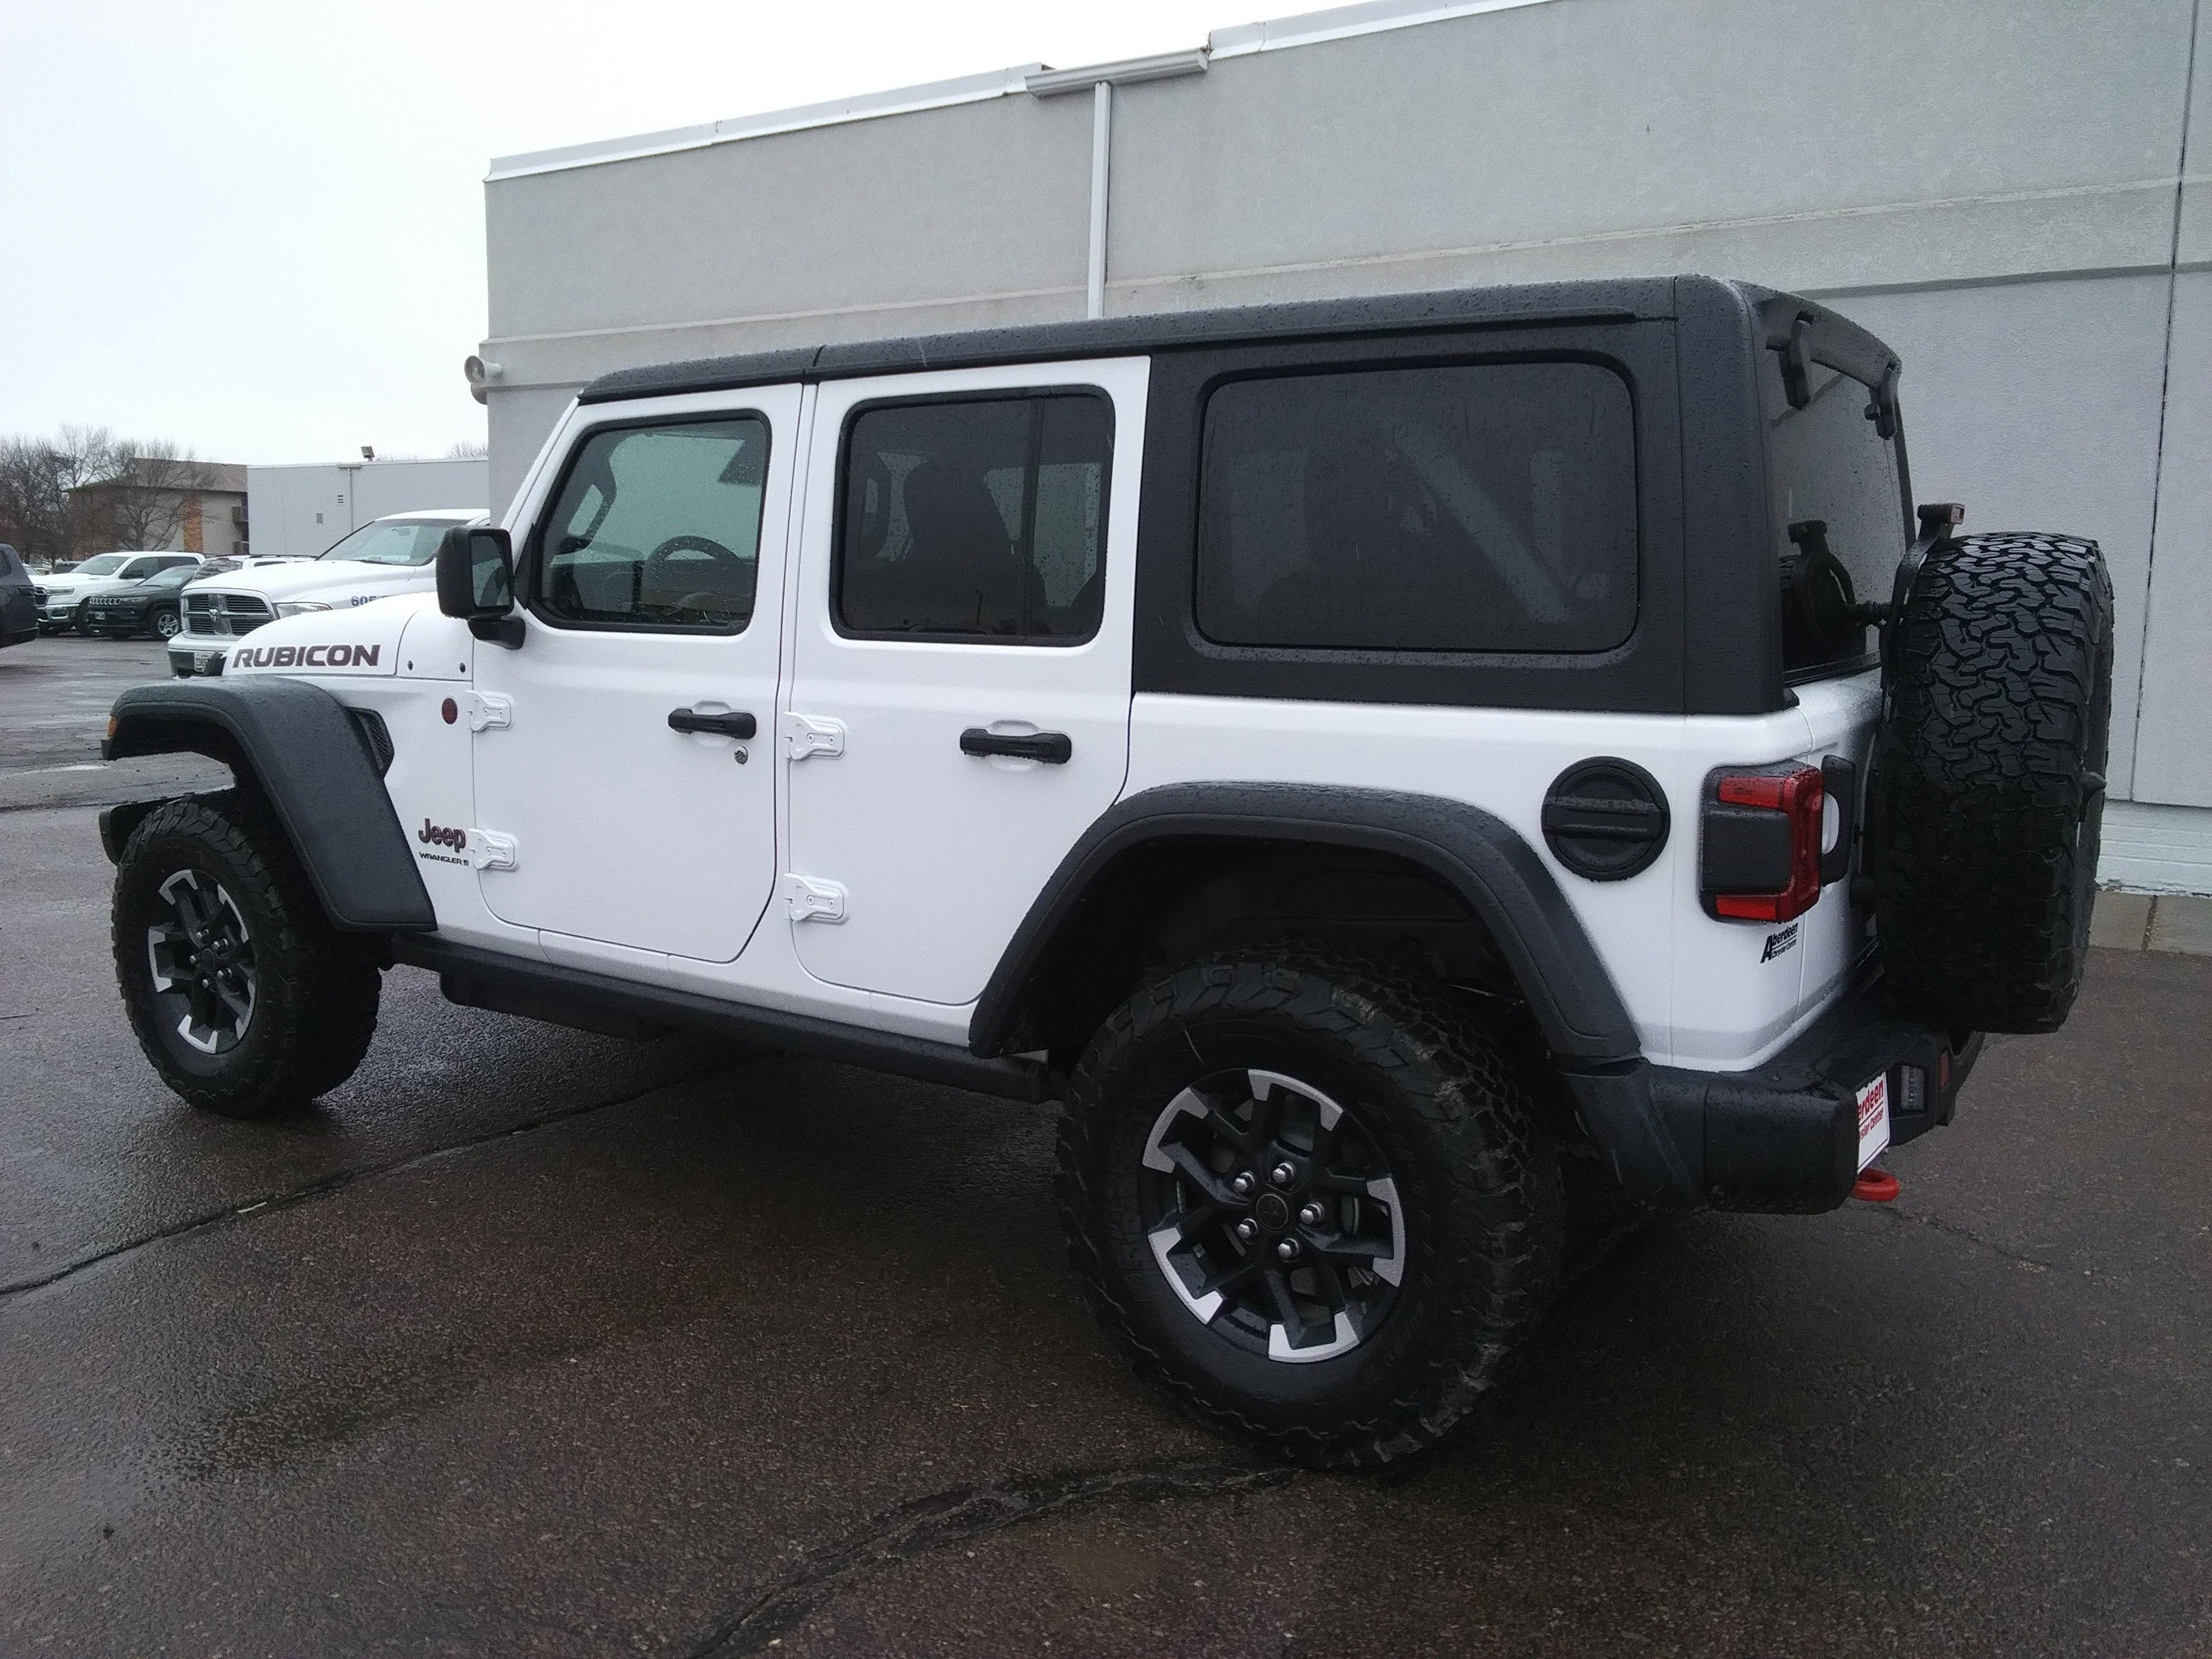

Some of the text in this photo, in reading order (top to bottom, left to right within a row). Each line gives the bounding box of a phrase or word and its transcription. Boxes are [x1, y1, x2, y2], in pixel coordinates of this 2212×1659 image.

[232, 644, 380, 668] RUBICON
[418, 818, 466, 853] Jeep
[419, 851, 462, 865] WRANGLER
[1760, 922, 1798, 964] Aberdeen
